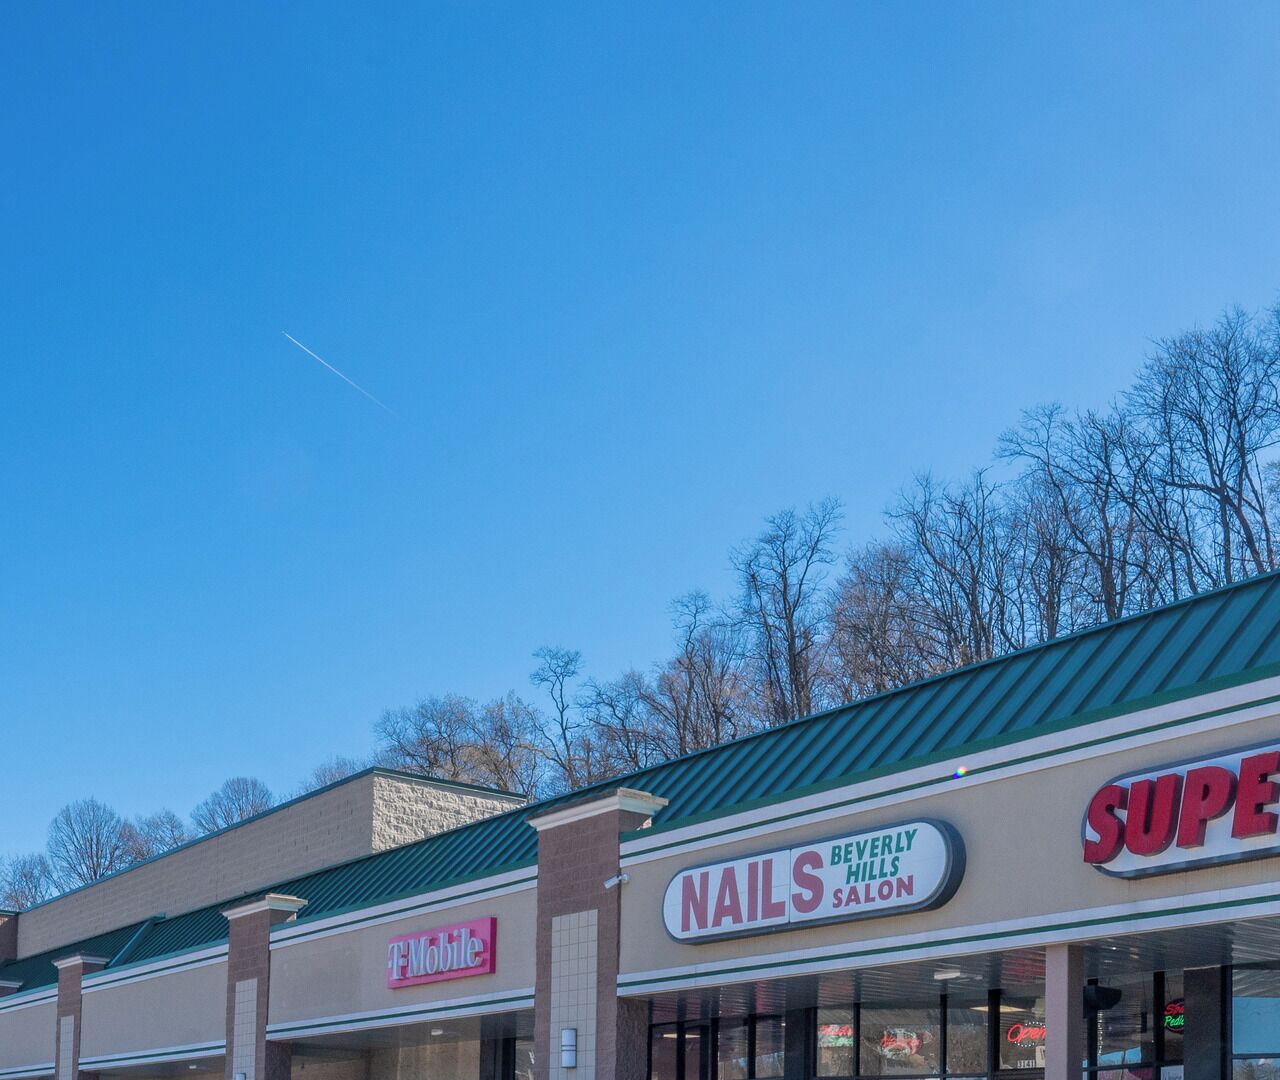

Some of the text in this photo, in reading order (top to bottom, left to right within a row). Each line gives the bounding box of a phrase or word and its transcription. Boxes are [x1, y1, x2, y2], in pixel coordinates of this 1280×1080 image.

[830, 828, 920, 866] BEVERLY
[845, 856, 901, 885] HILLS
[680, 850, 825, 933] NAILS
[832, 875, 914, 909] SALON
[1007, 1023, 1046, 1044] Open
